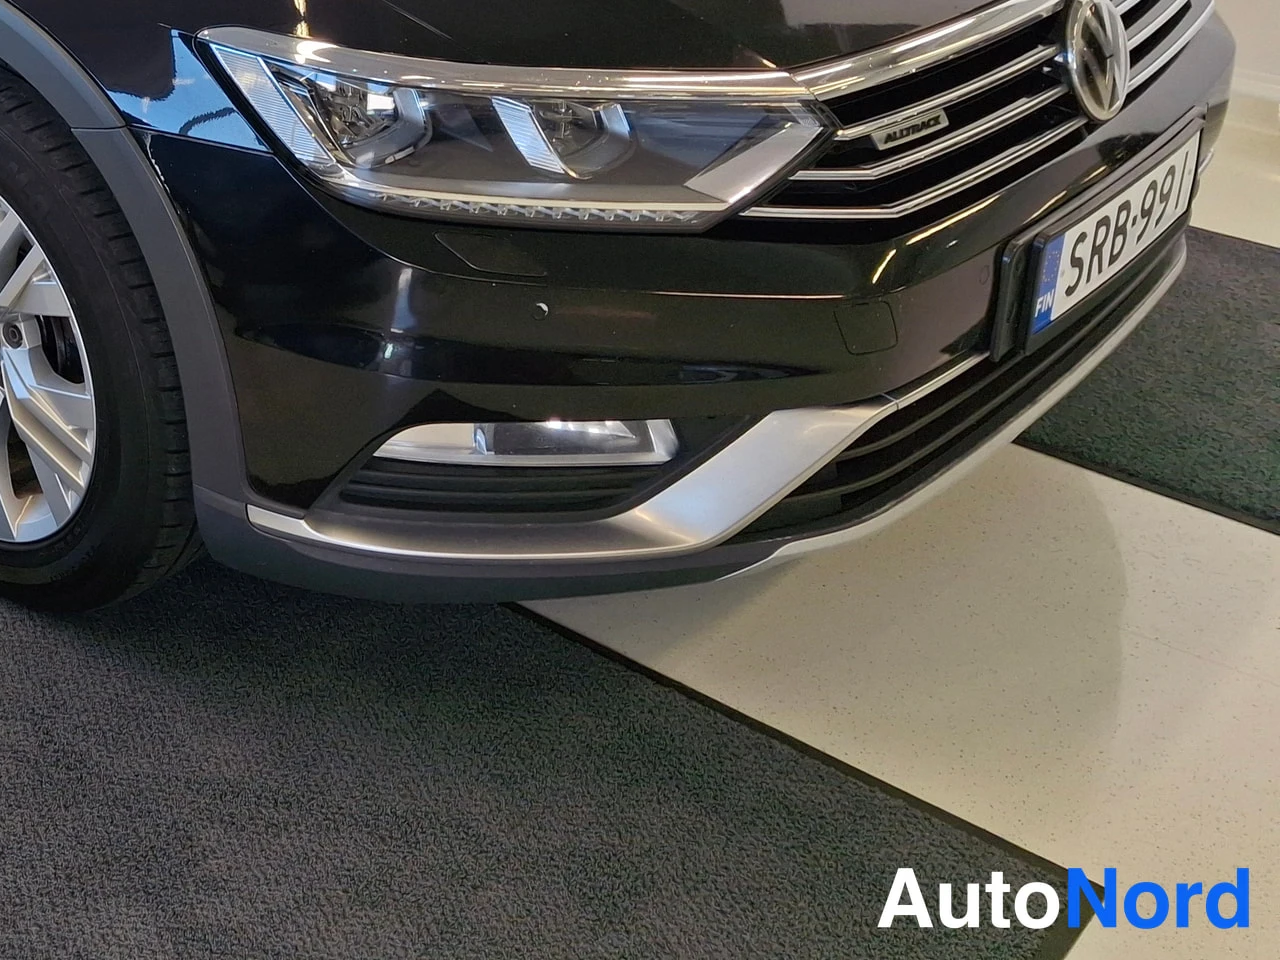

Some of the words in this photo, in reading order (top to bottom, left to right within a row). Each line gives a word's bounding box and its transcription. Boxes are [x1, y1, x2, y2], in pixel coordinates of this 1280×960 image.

[884, 114, 941, 144] ALLTRACK
[1065, 150, 1190, 297] SRB-991
[1035, 288, 1055, 317] FIN
